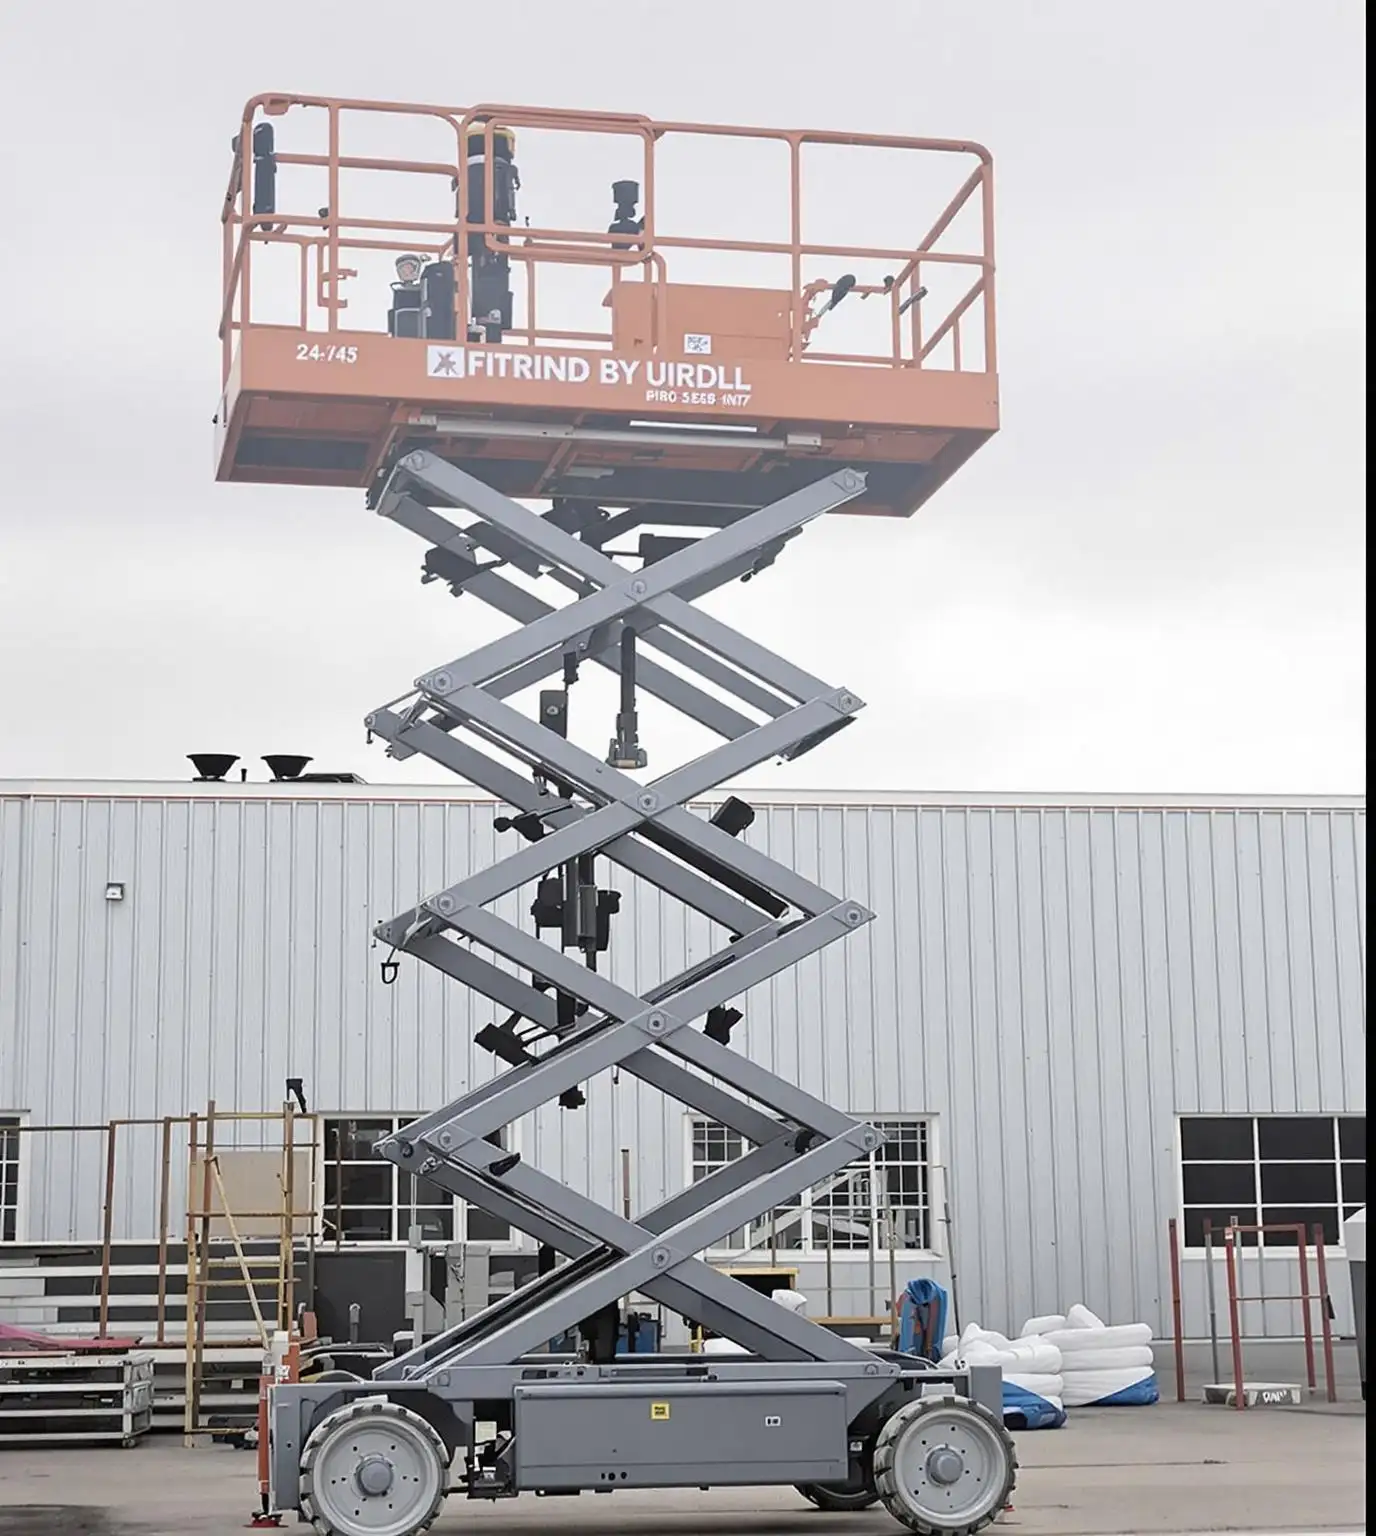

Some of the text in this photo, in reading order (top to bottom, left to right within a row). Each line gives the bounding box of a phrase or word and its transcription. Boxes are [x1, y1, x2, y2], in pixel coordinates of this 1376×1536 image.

[468, 350, 752, 391] FITRIND BY UIRDLL
